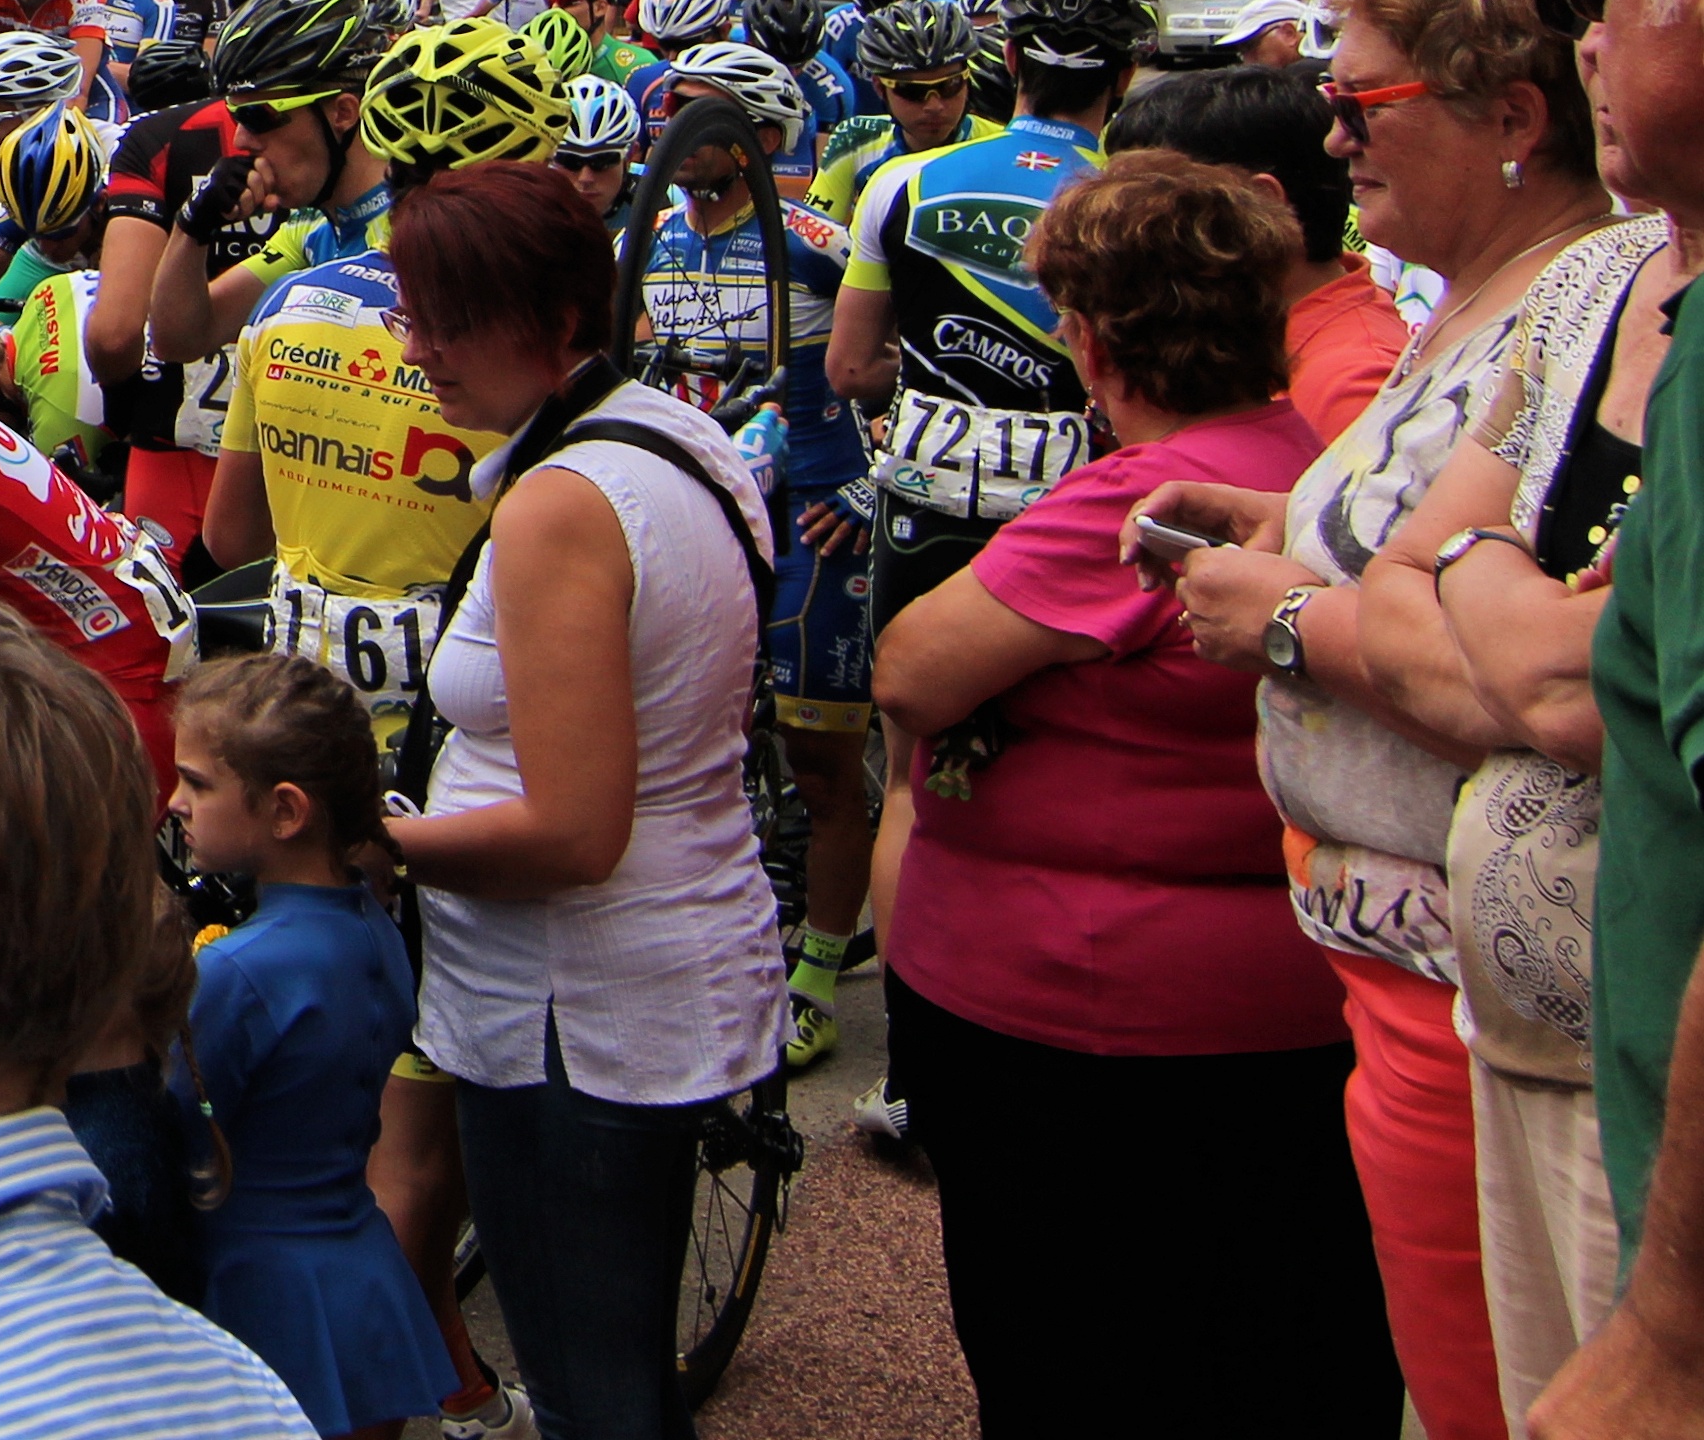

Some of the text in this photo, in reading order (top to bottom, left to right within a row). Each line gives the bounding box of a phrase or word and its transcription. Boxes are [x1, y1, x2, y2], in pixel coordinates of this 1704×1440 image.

[306, 288, 349, 310] LOIRE
[270, 338, 342, 373] Crédit
[932, 319, 1053, 388] CAMPOS
[267, 366, 412, 409] LA banque à qui
[260, 421, 394, 482] roannais
[993, 417, 1083, 481] 172
[279, 466, 436, 514] AGGLOMERATION
[34, 555, 98, 613] VENDÉE
[88, 614, 111, 636] U
[343, 604, 425, 693] 61
